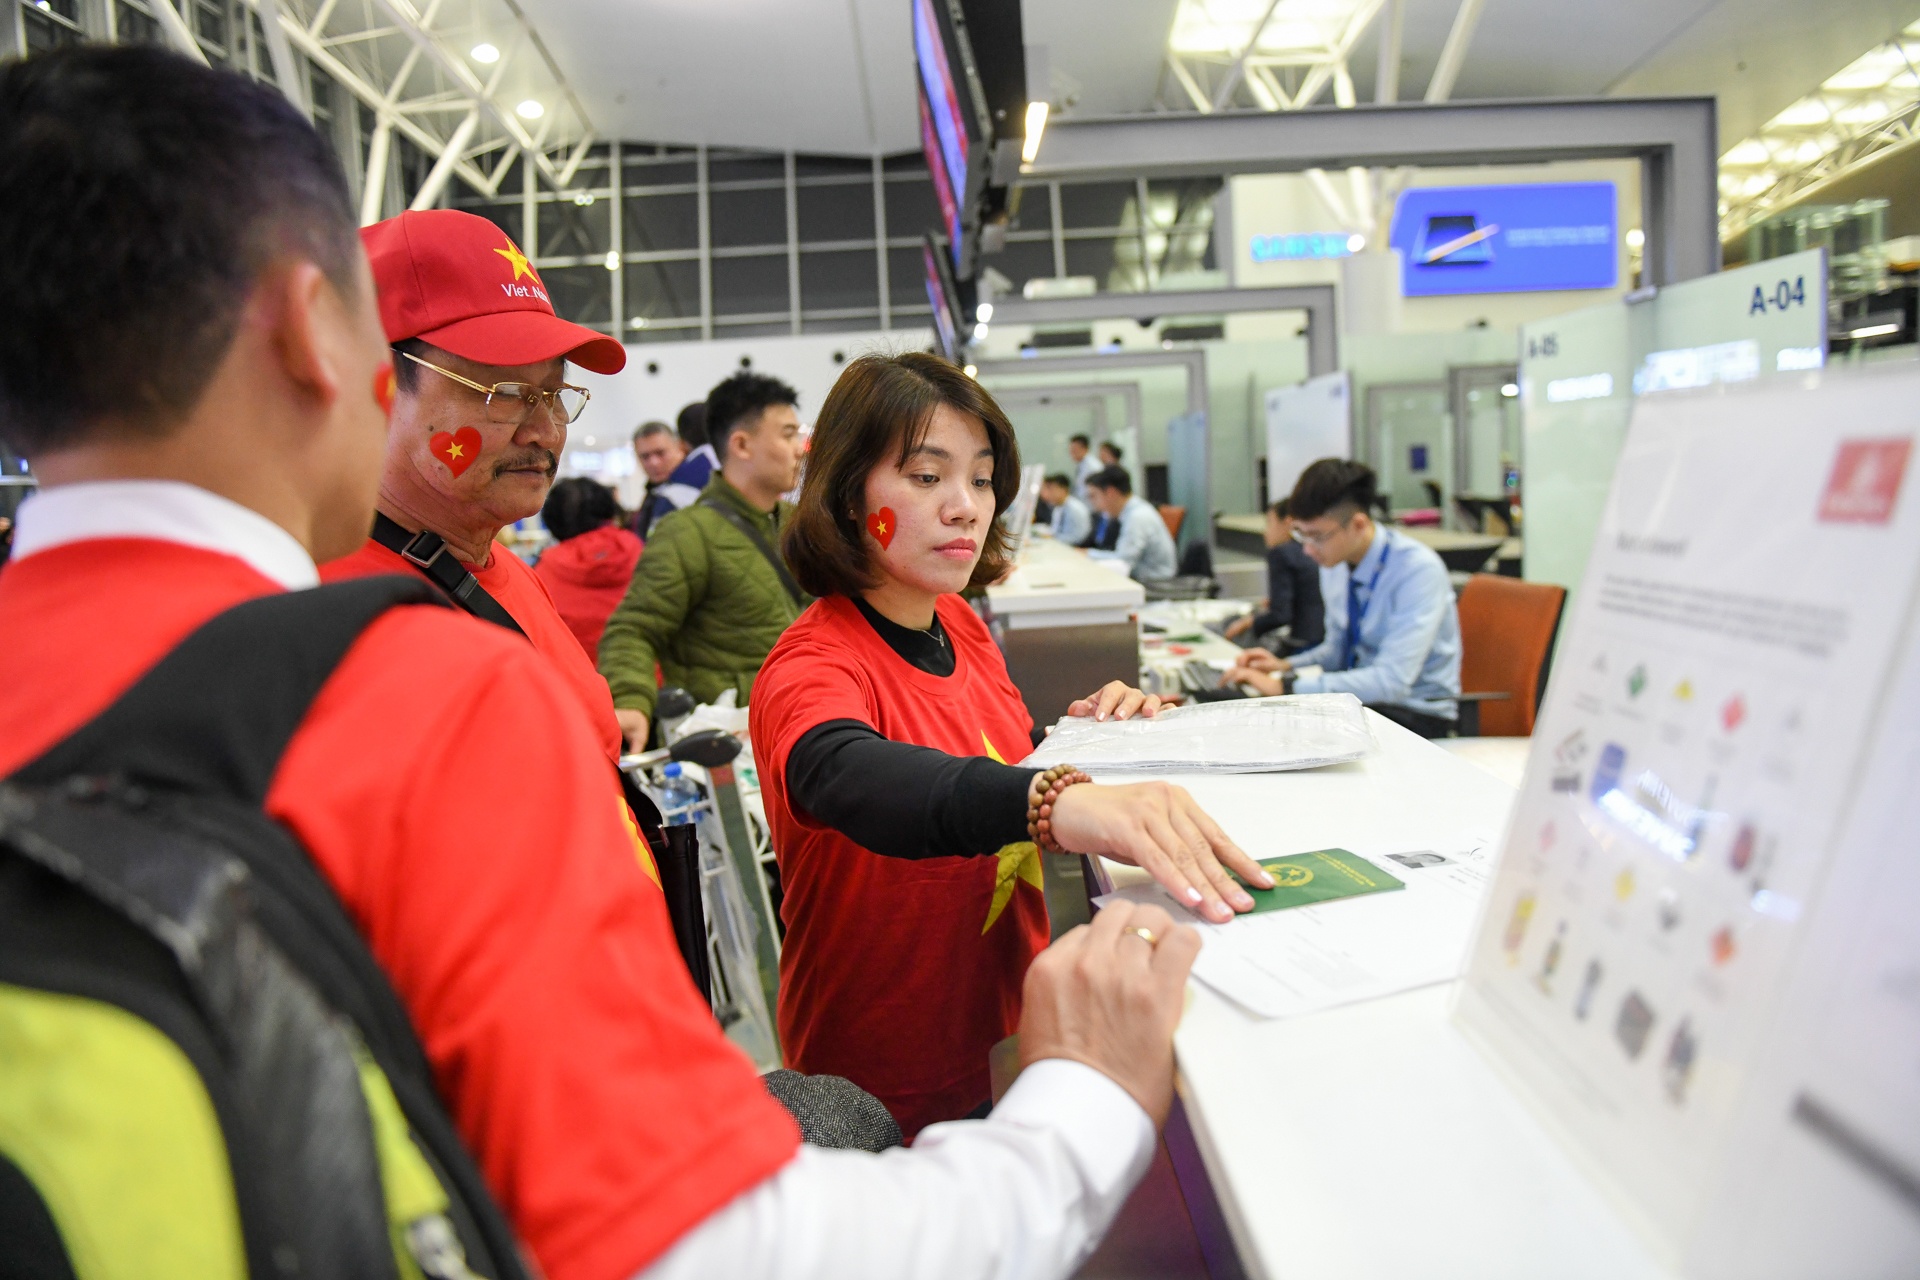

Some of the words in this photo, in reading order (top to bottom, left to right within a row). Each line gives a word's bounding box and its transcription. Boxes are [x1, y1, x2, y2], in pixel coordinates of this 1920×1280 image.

[1251, 233, 1358, 261] SAMSU
[501, 283, 530, 297] Viet
[1749, 276, 1804, 316] A-04
